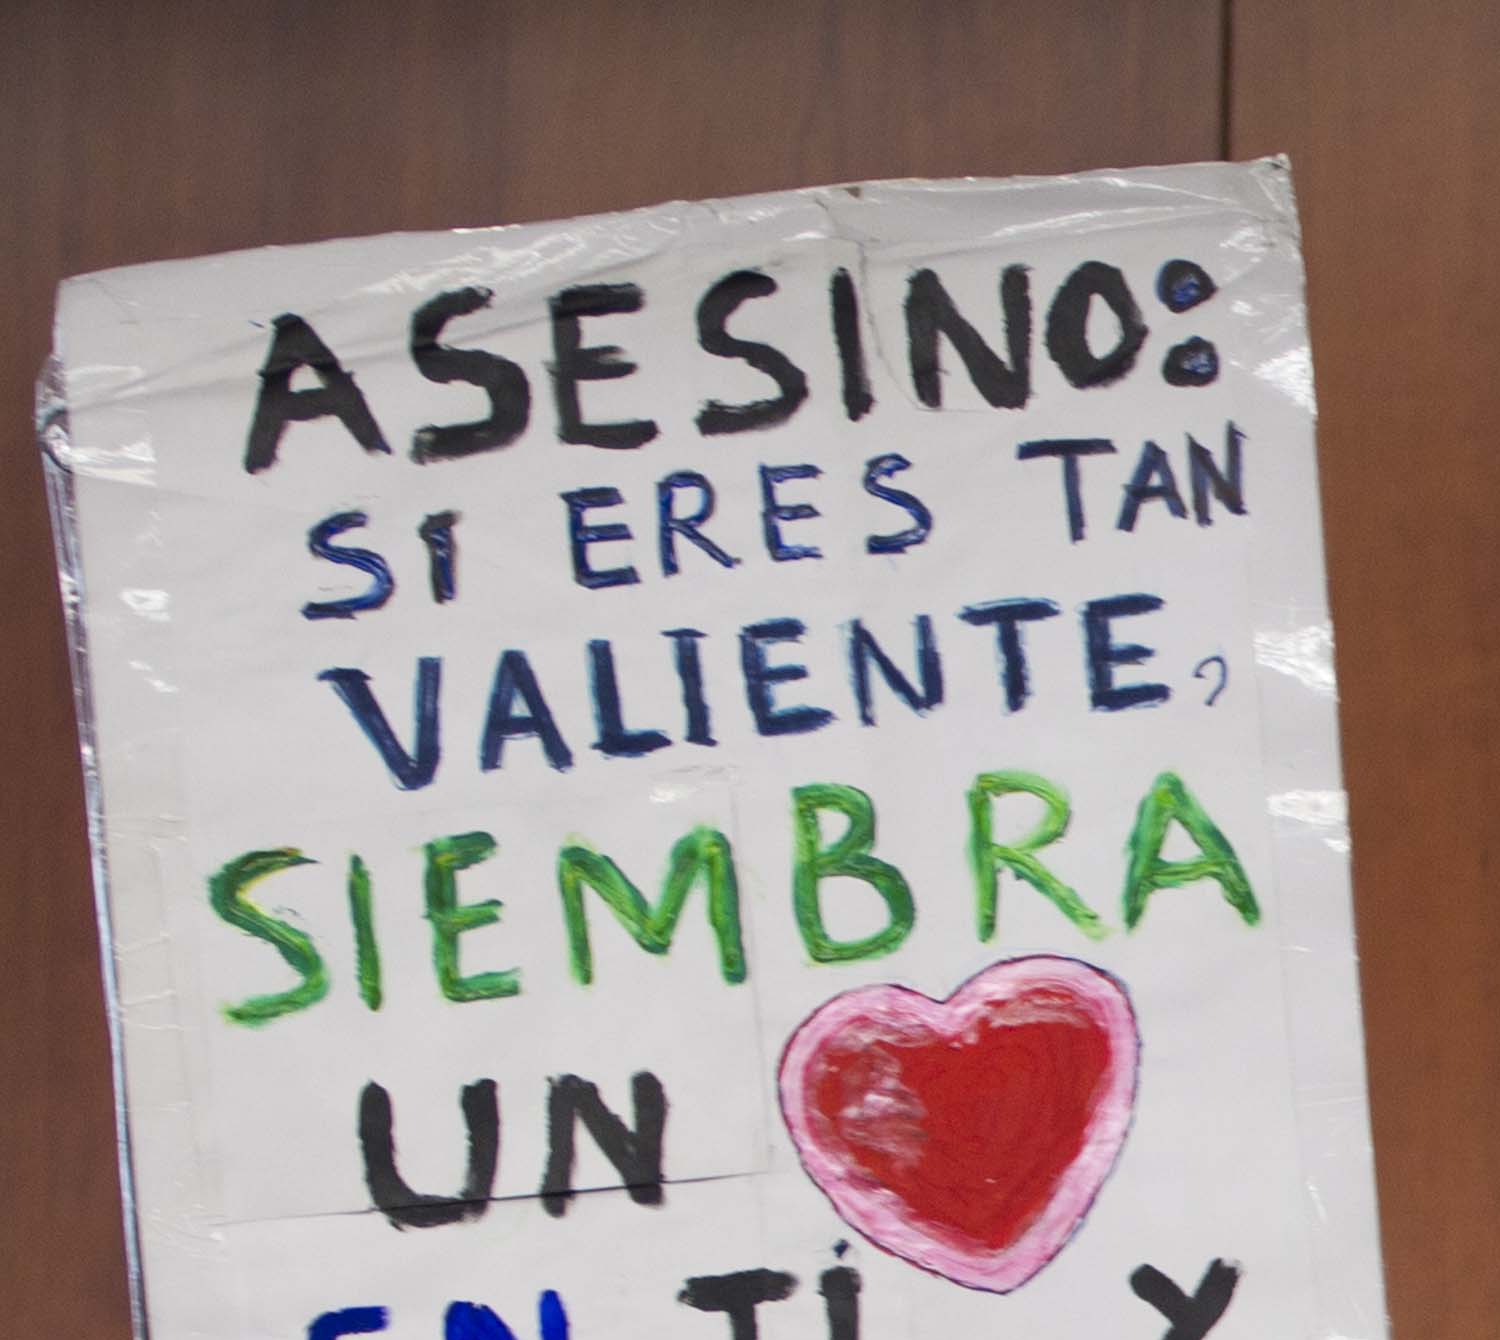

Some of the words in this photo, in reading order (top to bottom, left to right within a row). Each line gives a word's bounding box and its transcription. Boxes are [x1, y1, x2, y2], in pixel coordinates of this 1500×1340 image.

[244, 257, 1219, 475] ASESINO:
[302, 510, 460, 618] SI
[567, 454, 934, 588] ERES
[1017, 422, 1249, 542] TAN
[319, 594, 1228, 791] VALIENTE,
[208, 771, 1261, 1027] SIEMBRA
[357, 1070, 666, 1229] UN
